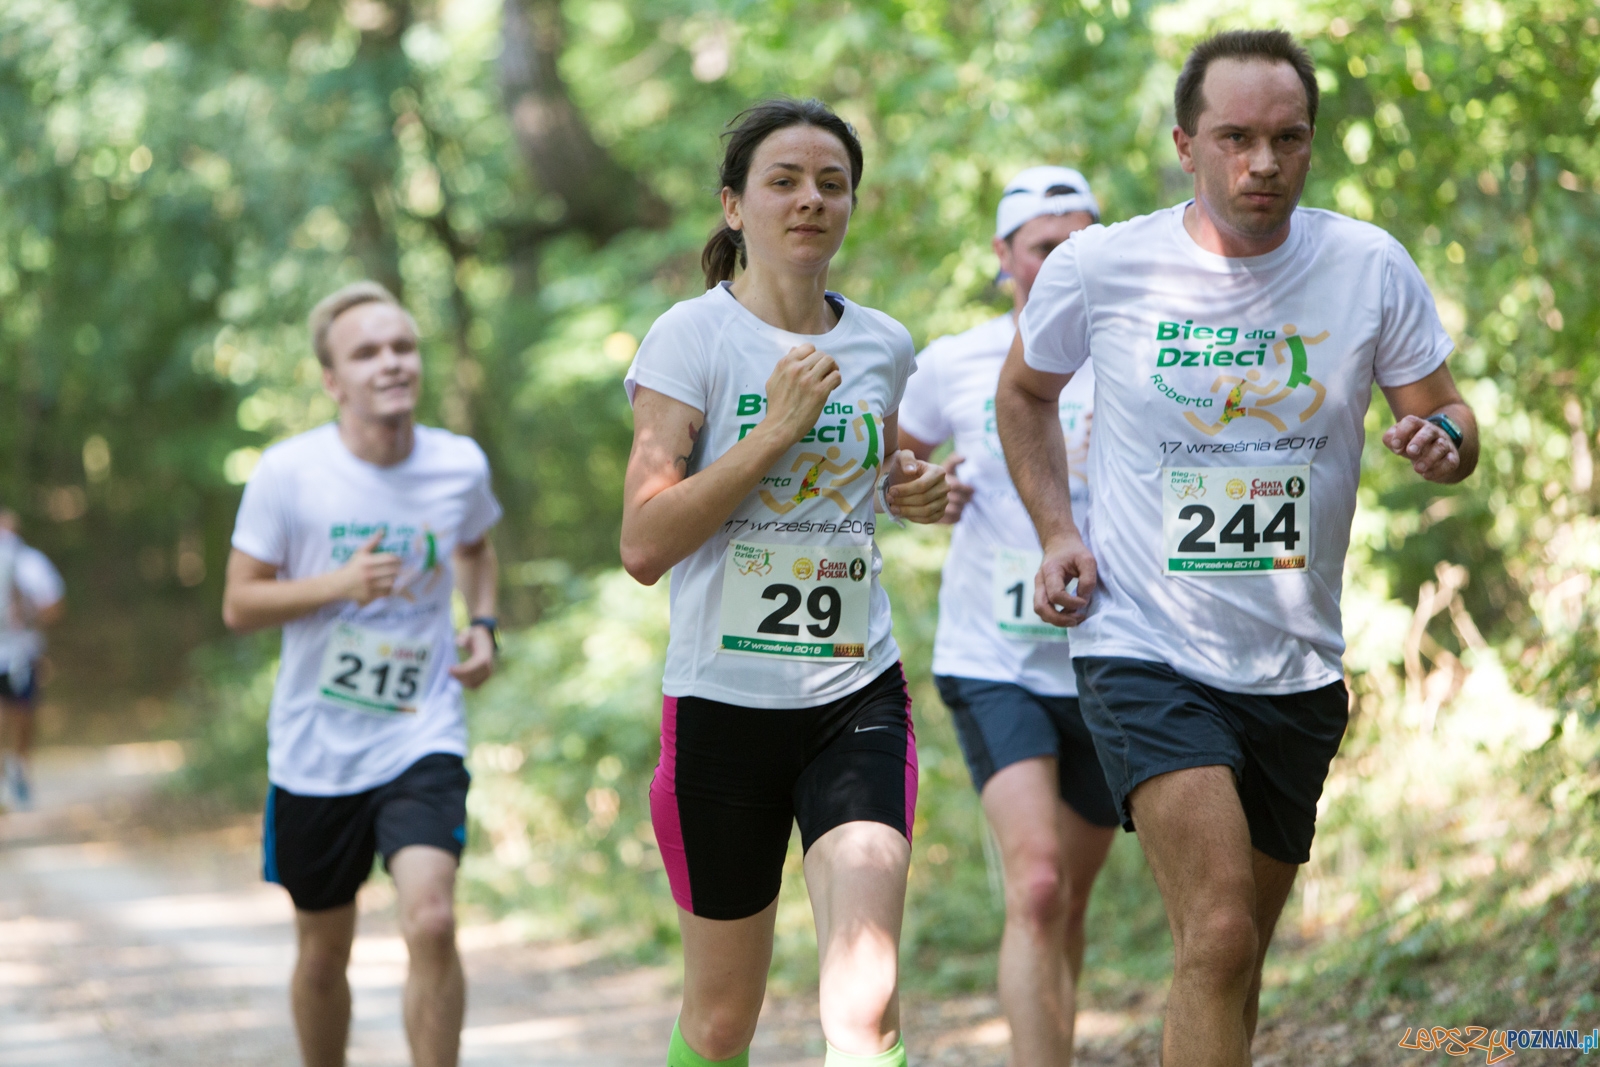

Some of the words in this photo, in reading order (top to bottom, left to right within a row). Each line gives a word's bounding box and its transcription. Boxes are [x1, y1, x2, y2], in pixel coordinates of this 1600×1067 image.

[1156, 319, 1239, 346] Bieg
[1244, 329, 1276, 340] dla
[1156, 343, 1267, 367] Dzieci
[1150, 373, 1213, 408] Roberta
[823, 402, 853, 415] dla
[1159, 441, 1182, 454] 17
[1186, 439, 1271, 454] września
[1274, 436, 1329, 451] 2016
[724, 519, 749, 533] 17
[751, 519, 836, 533] września
[837, 520, 875, 536] 2016
[1177, 502, 1300, 552] 244
[1181, 561, 1194, 569] 17
[1233, 560, 1260, 568] 2016
[756, 583, 842, 638] 29
[737, 639, 751, 648] 17
[792, 645, 822, 654] 2016
[333, 652, 420, 700] 215
